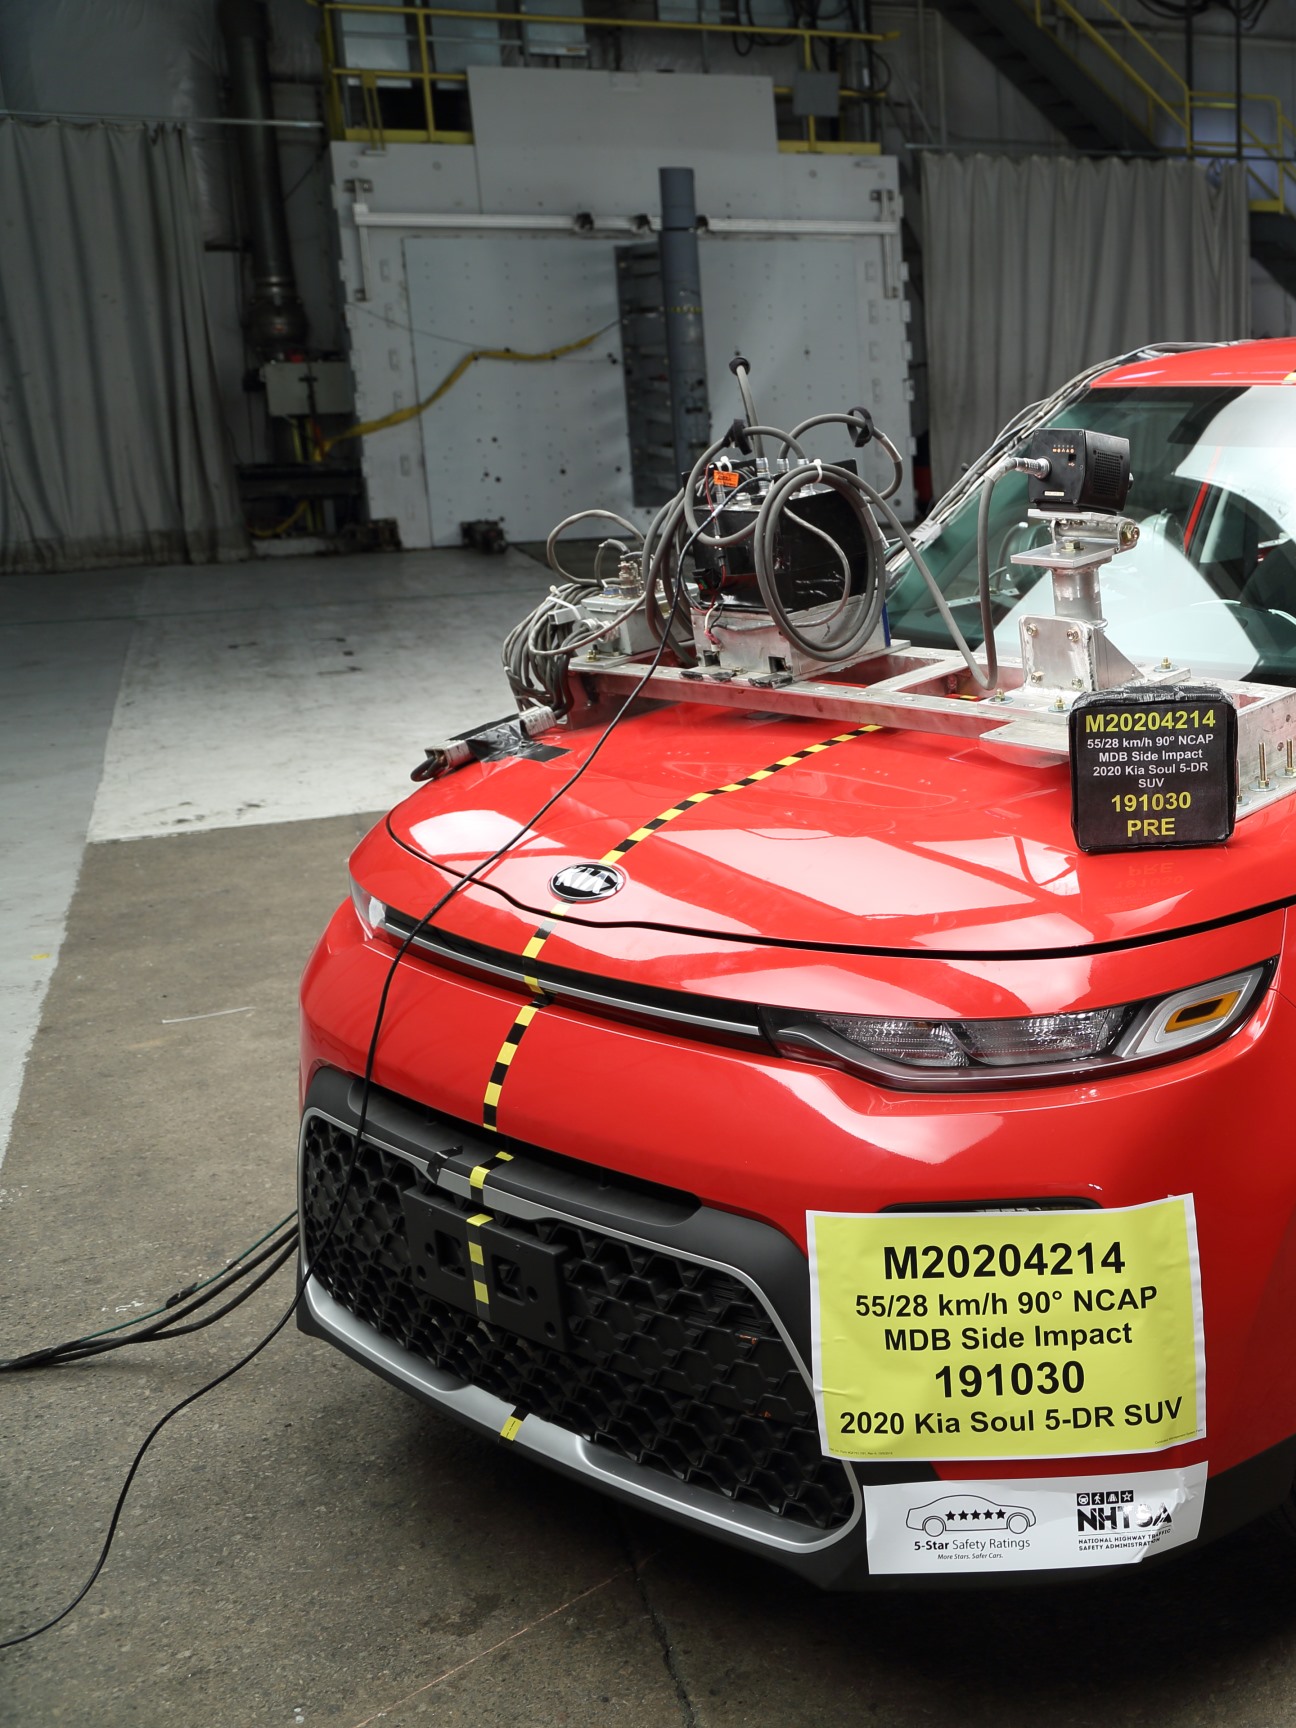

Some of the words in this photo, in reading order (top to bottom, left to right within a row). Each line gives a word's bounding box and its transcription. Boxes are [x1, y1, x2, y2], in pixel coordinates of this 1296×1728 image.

[1085, 709, 1216, 733] M20204214
[1087, 738, 1119, 749] 55/28
[1123, 736, 1152, 748] km/h
[1178, 733, 1214, 746] NCAP
[1099, 751, 1128, 762] MDB
[1131, 750, 1159, 761] Side
[1162, 749, 1203, 762] Impact
[1093, 766, 1122, 776] 2020
[1125, 765, 1145, 776] Kia
[1148, 763, 1176, 775] Soul
[1179, 762, 1209, 773] 5-DR
[1138, 778, 1165, 788] SUV
[1111, 791, 1192, 813] 191030
[1127, 818, 1176, 837] PRE
[883, 1241, 1126, 1280] M20204214
[855, 1294, 929, 1318] 55/28
[938, 1292, 1008, 1317] km/h
[1017, 1290, 1063, 1314] 90°
[1073, 1285, 1158, 1313] NCAP
[884, 1328, 951, 1351] MDB
[961, 1326, 1025, 1350] Side
[1034, 1322, 1133, 1351] Impact
[935, 1360, 1085, 1399] 191030
[839, 1411, 905, 1435] 2020
[914, 1412, 961, 1435] Kia
[970, 1409, 1035, 1434] Soul
[1045, 1406, 1115, 1431] 5-DR
[1124, 1396, 1183, 1427] SUV
[1077, 1502, 1173, 1532] NHTSA
[914, 1540, 950, 1551] 5-Star
[952, 1539, 987, 1551] Safety
[989, 1538, 1031, 1551] Ratings
[1078, 1536, 1113, 1545] NATIONAL
[1114, 1534, 1146, 1543] HIGHWAY
[1147, 1528, 1172, 1540] TRAFFIC
